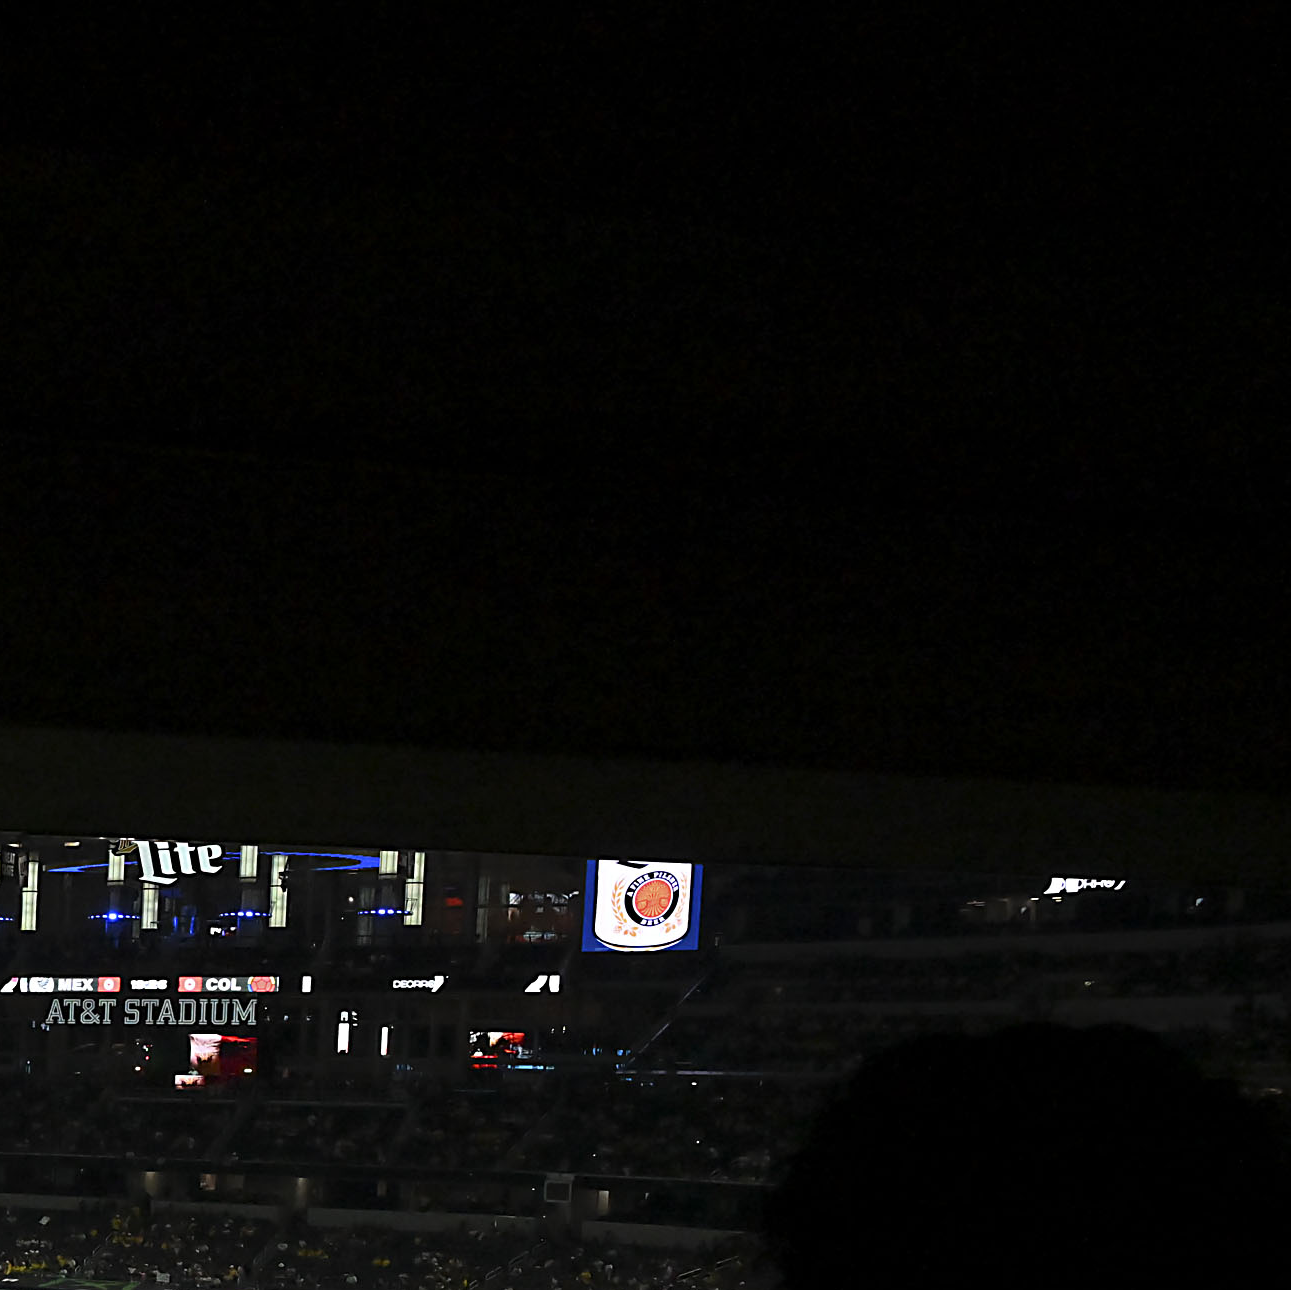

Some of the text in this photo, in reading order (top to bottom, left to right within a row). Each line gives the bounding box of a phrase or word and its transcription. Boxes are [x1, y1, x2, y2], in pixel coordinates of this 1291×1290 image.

[136, 840, 223, 884] Lite
[58, 978, 94, 991] MEX
[205, 978, 241, 991] COL
[46, 998, 257, 1025] AT&T STADIUM
